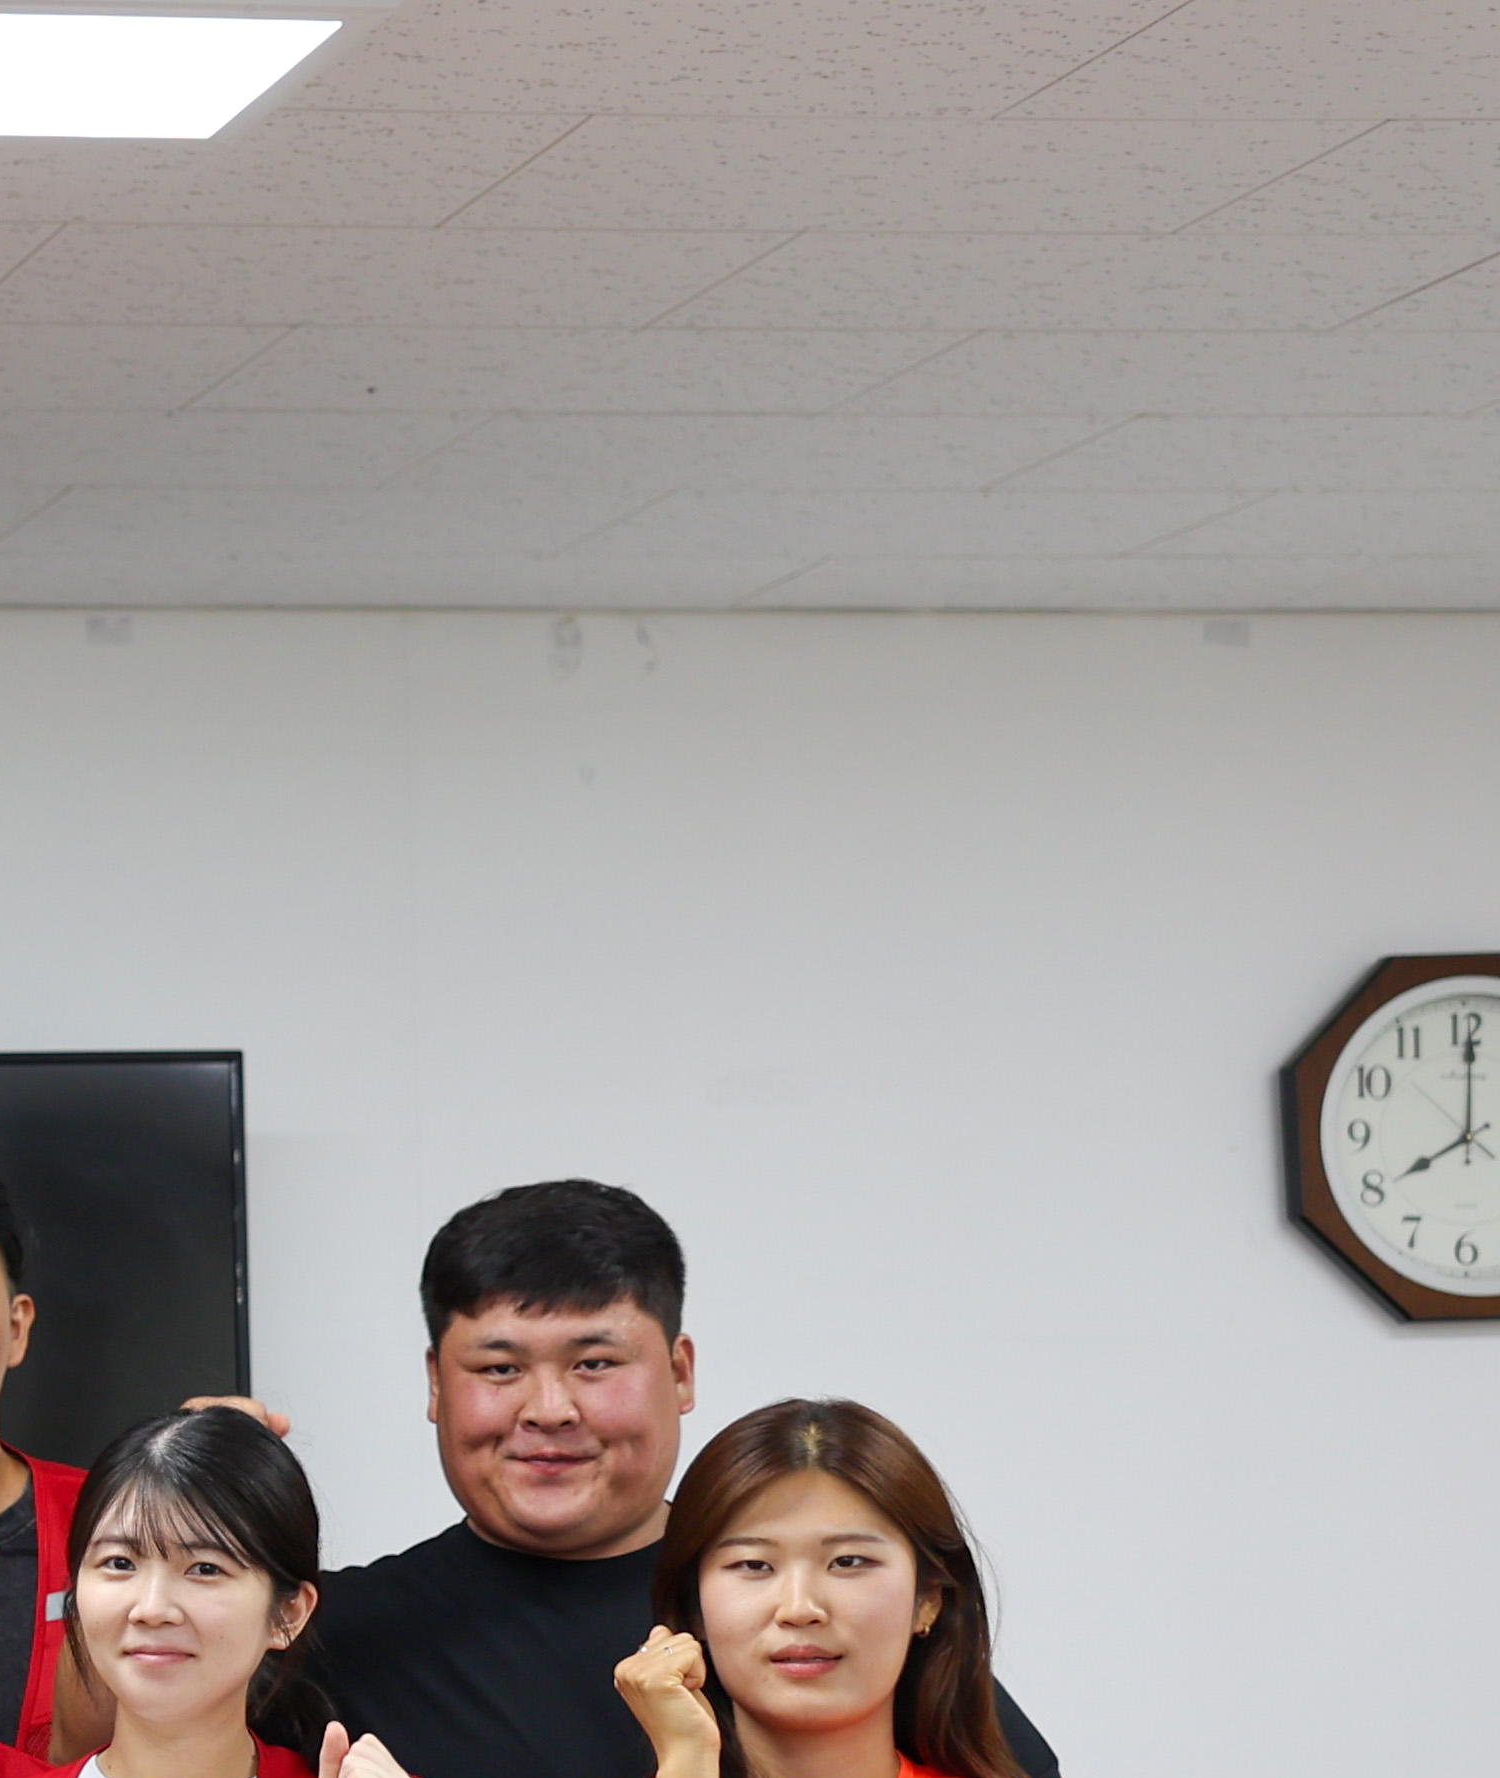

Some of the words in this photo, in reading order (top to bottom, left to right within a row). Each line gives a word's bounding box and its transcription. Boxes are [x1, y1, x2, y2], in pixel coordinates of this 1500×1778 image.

[1397, 1026, 1420, 1059] 11
[1450, 1012, 1482, 1047] 12
[1357, 1064, 1391, 1099] 10
[1347, 1119, 1370, 1152] 9
[1360, 1170, 1384, 1207] 8
[1402, 1216, 1421, 1248] 7
[1454, 1231, 1478, 1266] 6
